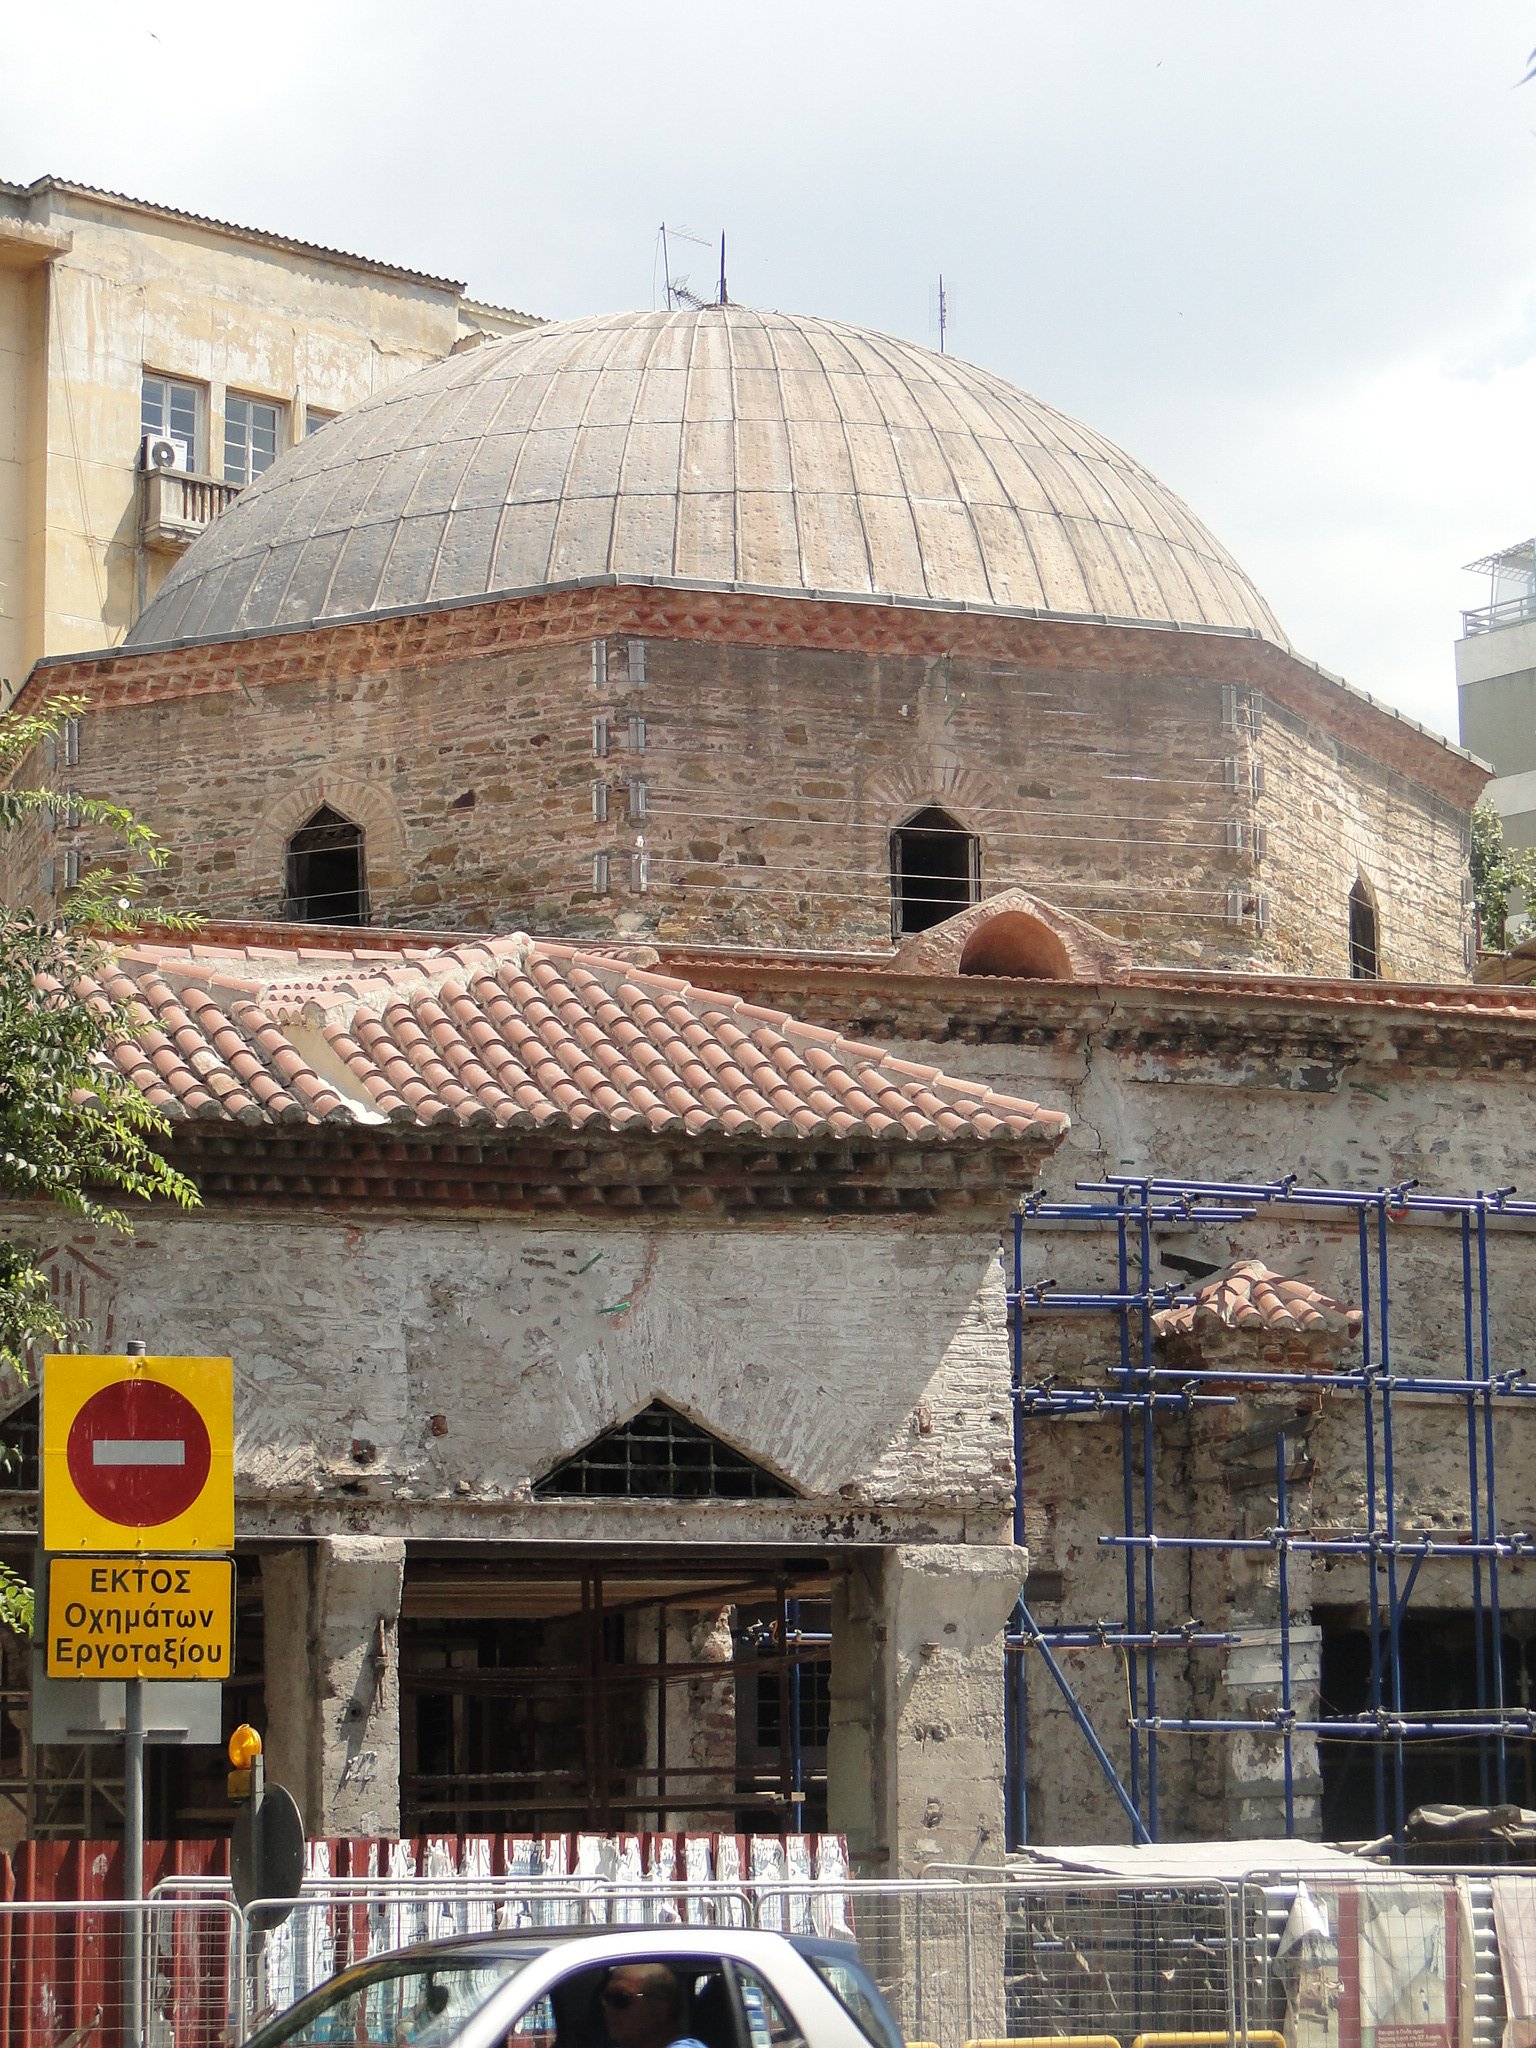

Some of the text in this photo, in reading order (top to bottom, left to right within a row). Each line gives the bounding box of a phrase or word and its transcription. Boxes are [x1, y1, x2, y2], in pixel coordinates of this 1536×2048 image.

[91, 1568, 191, 1593] ΕΚΤΟΣ
[65, 1602, 214, 1634] Οχημάτων
[56, 1637, 222, 1669] Εργοταξίου
